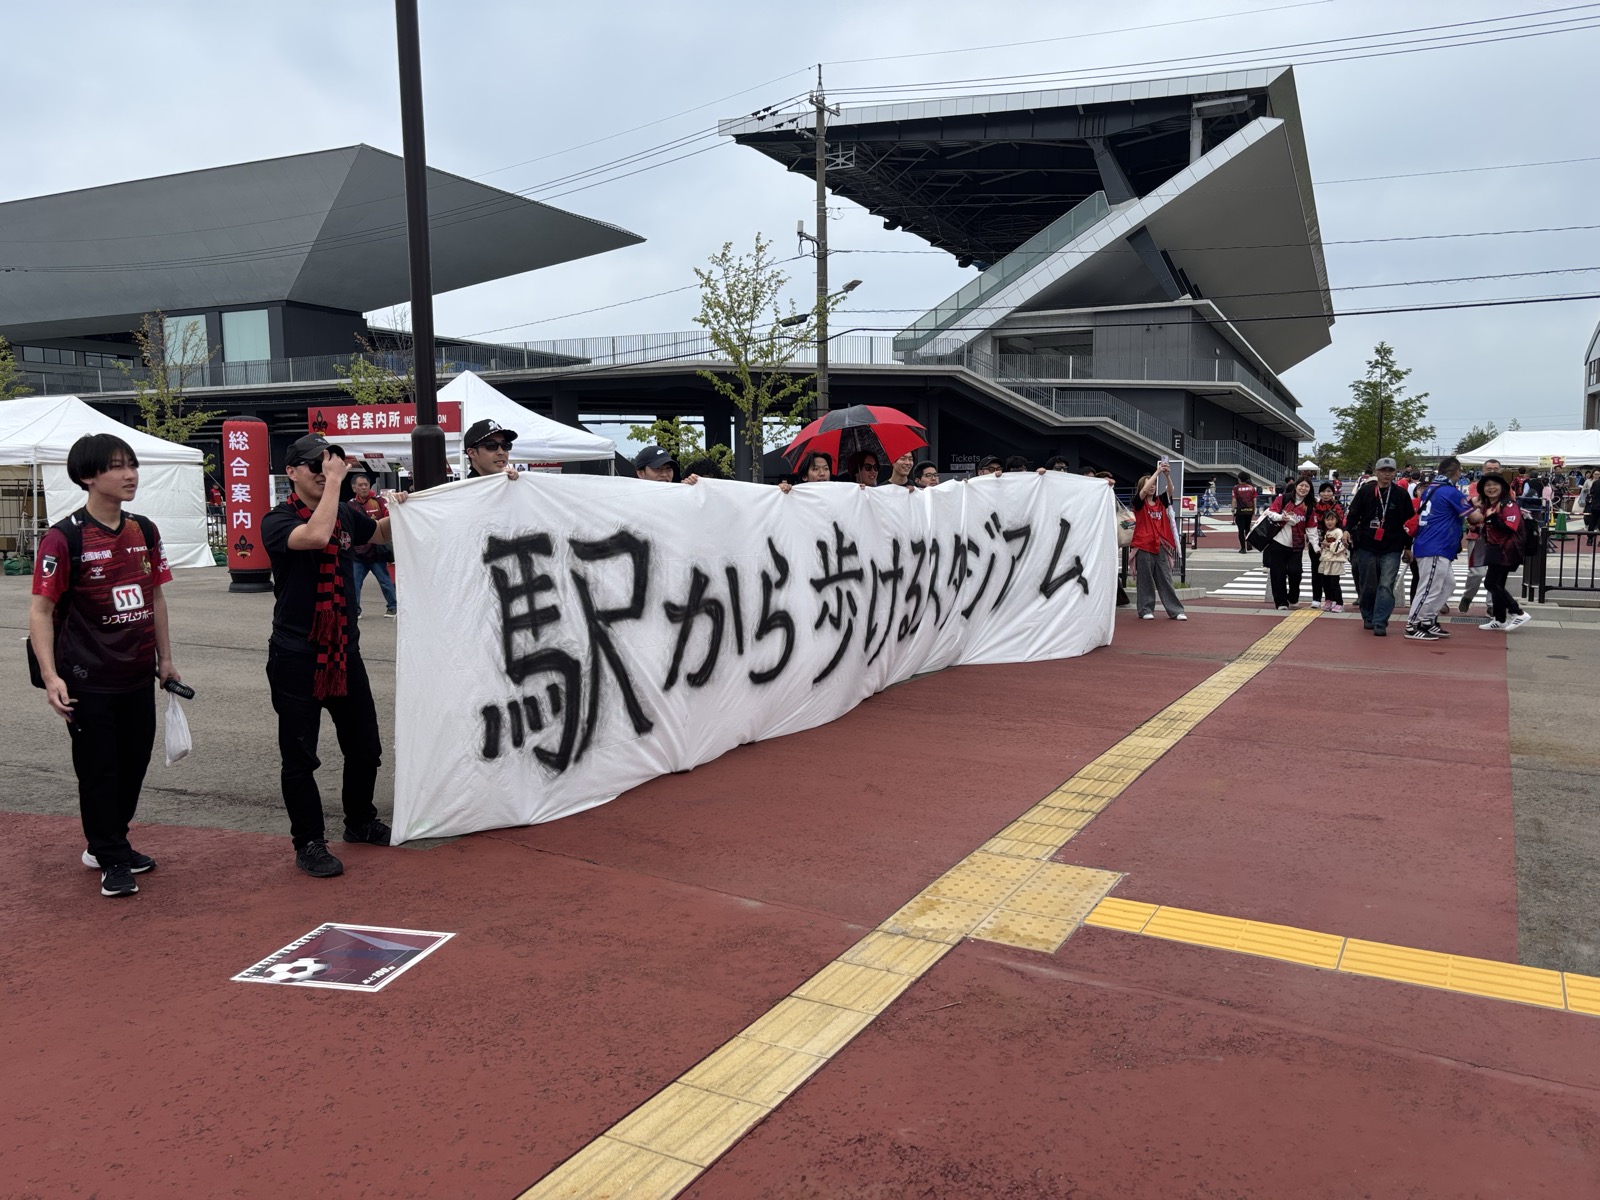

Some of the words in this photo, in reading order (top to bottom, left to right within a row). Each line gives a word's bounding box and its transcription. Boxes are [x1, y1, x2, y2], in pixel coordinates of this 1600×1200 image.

[336, 411, 400, 430] 総合案内所
[404, 414, 447, 425] INFOON
[1175, 439, 1181, 449] E
[951, 454, 981, 463] Tickets
[228, 431, 252, 529] 総合案内
[115, 588, 141, 608] STS
[480, 510, 1090, 774] 駅から歩けるスタジアム
